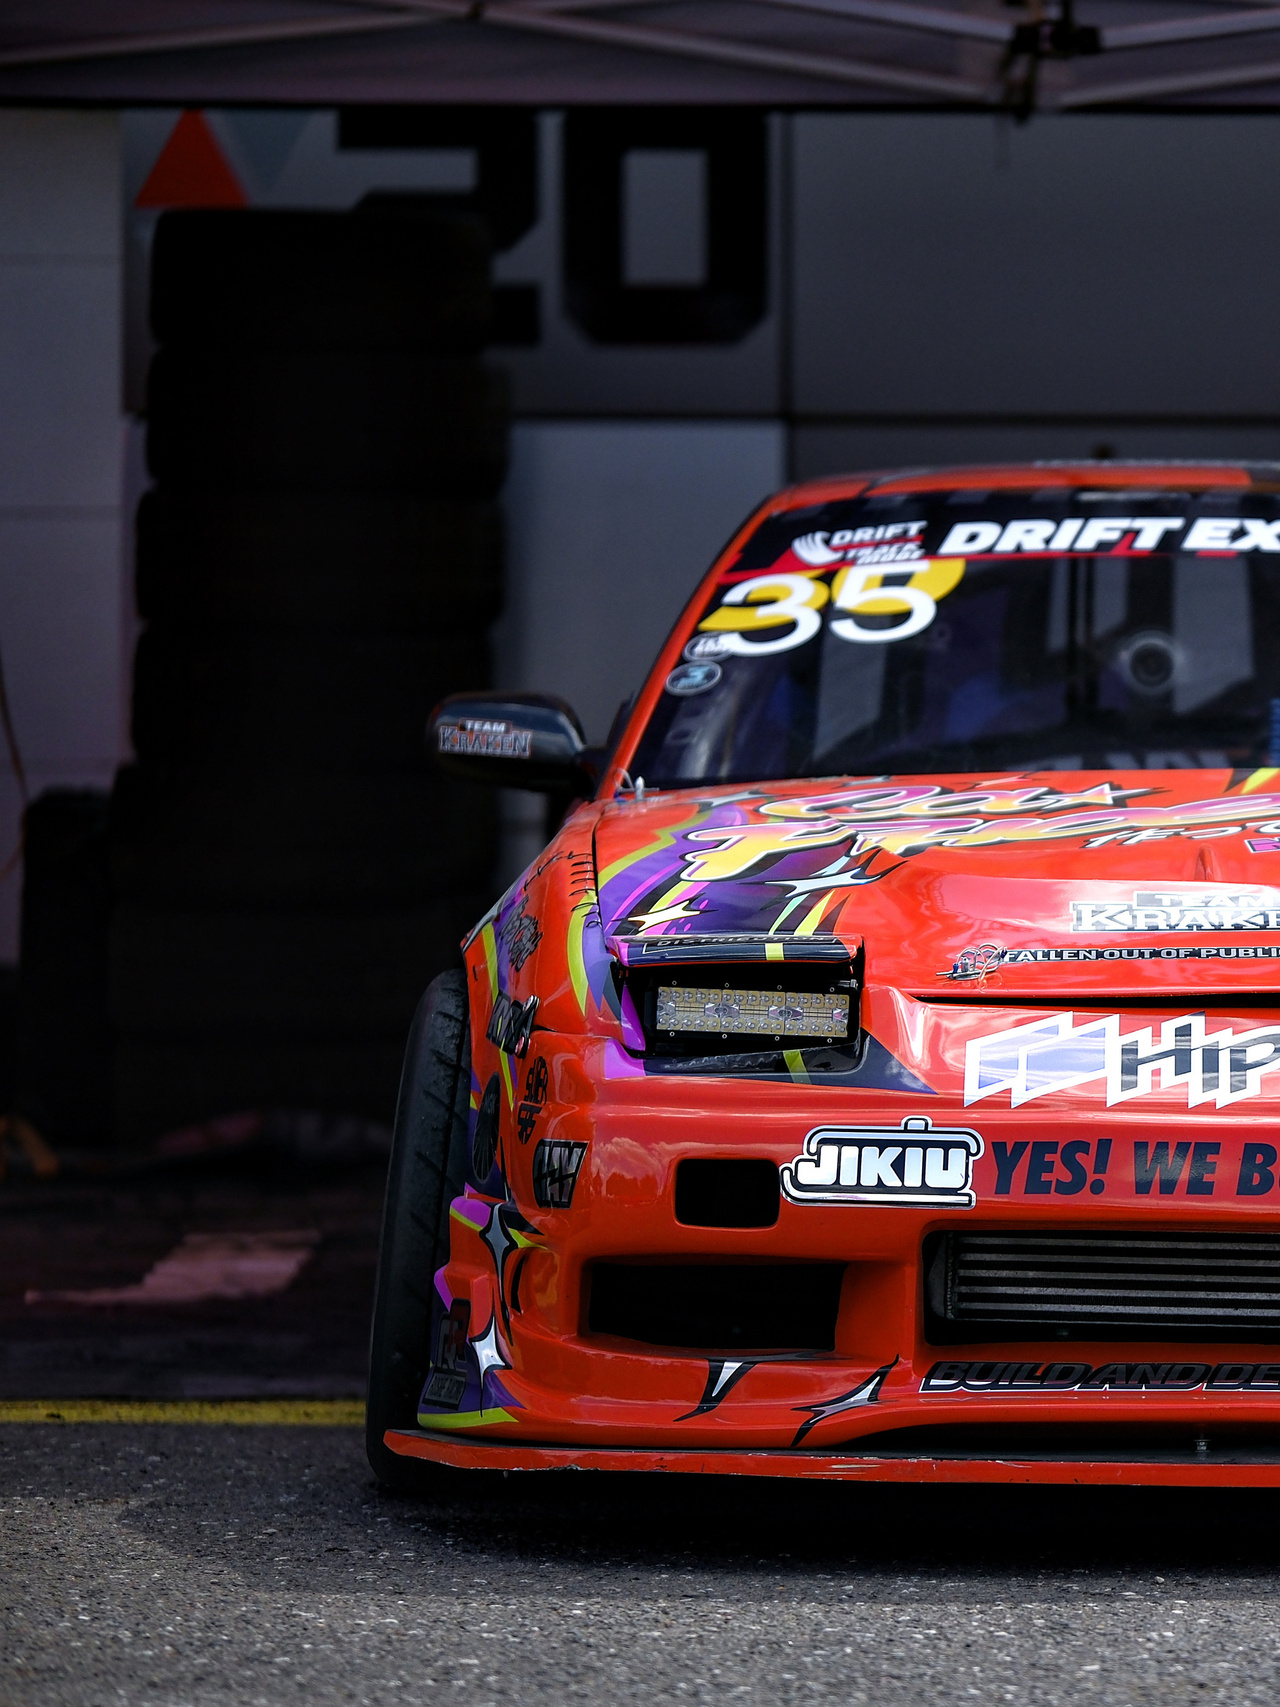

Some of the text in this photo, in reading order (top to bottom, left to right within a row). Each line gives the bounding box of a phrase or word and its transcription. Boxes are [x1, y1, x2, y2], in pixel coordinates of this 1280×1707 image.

[829, 519, 928, 545] DRIFT
[936, 516, 1186, 556] DRIFT
[714, 558, 940, 656] 35
[440, 727, 530, 756] KRAKEN
[465, 719, 506, 733] TEAM
[1003, 948, 1096, 962] FALLEN
[1103, 949, 1155, 961] OUT
[1161, 947, 1191, 960] OF
[796, 1144, 972, 1191] JIKIU
[991, 1138, 1114, 1197] YES!
[1132, 1139, 1221, 1198] WE
[919, 1361, 1088, 1393] BUILD
[1081, 1361, 1206, 1392] AND
